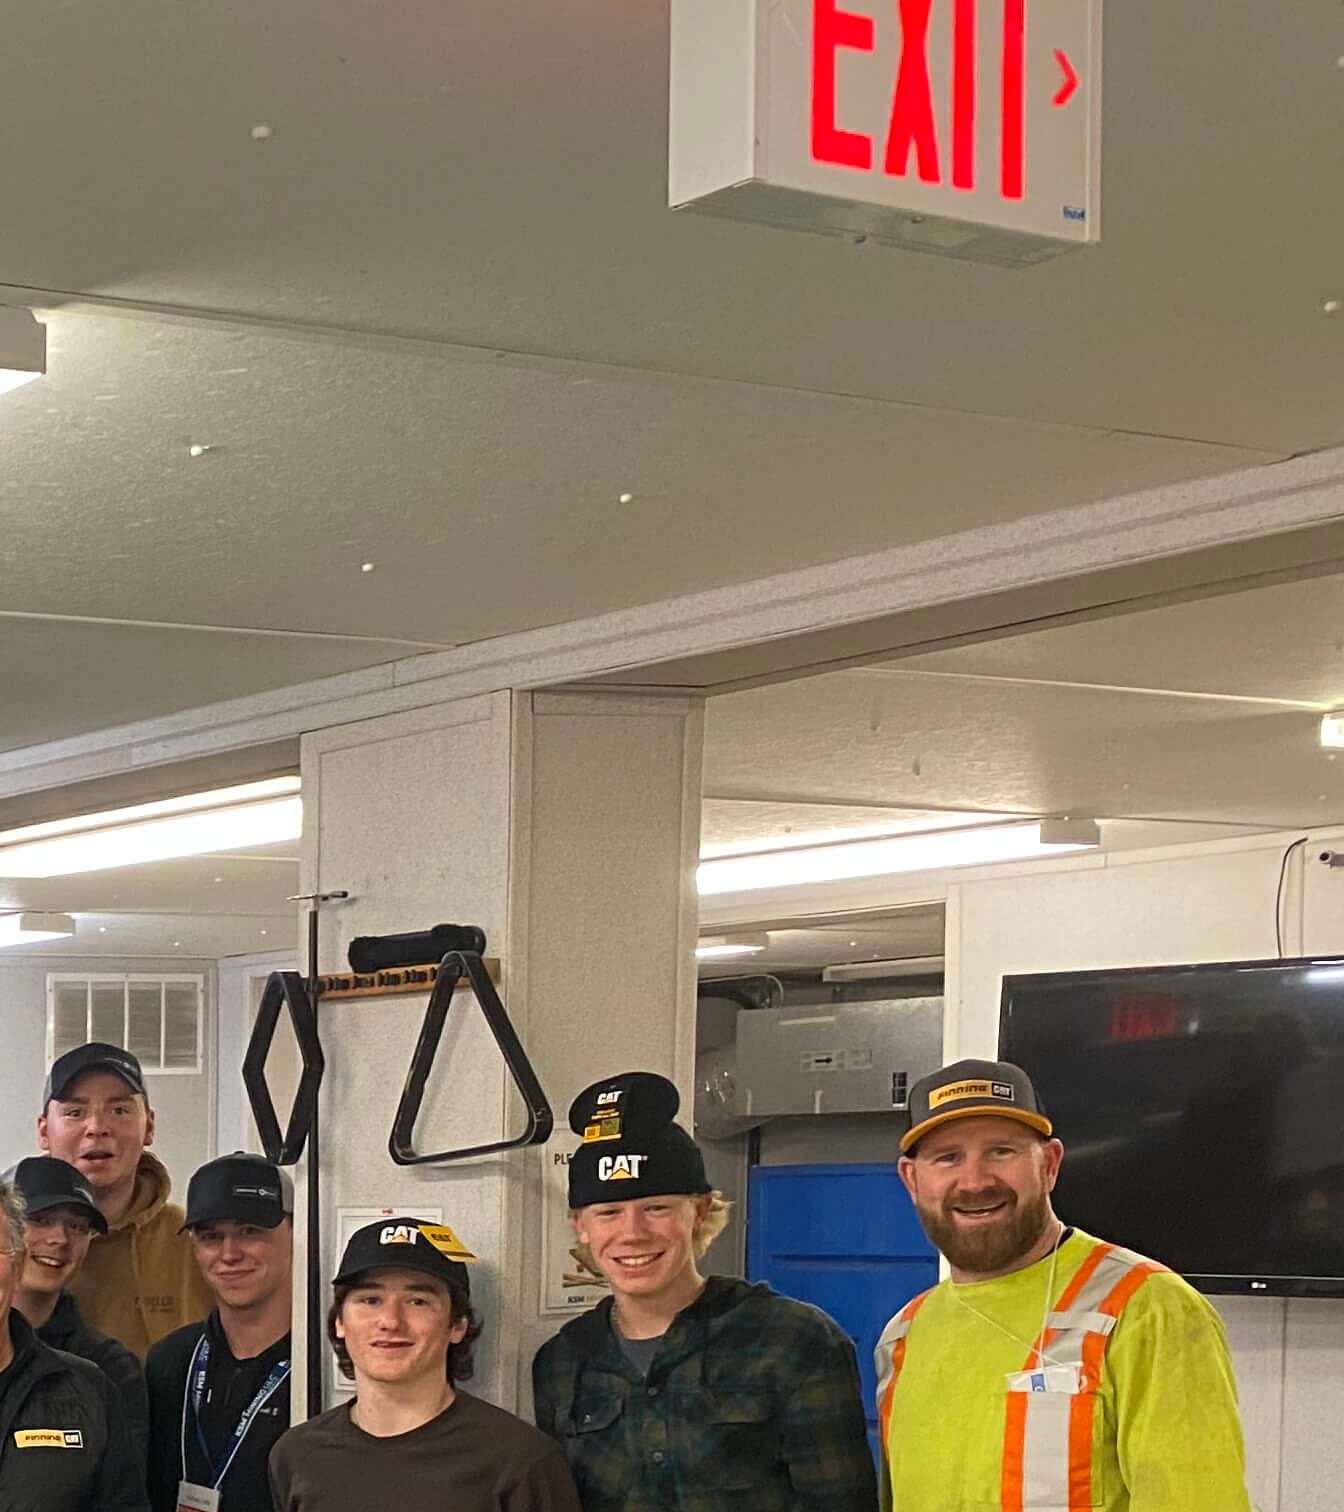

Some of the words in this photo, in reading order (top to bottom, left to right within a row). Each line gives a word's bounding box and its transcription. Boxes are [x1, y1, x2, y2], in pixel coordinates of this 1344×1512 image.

[597, 1090, 623, 1104] CAT
[598, 1154, 645, 1181] CAT
[380, 1225, 421, 1245] CAT
